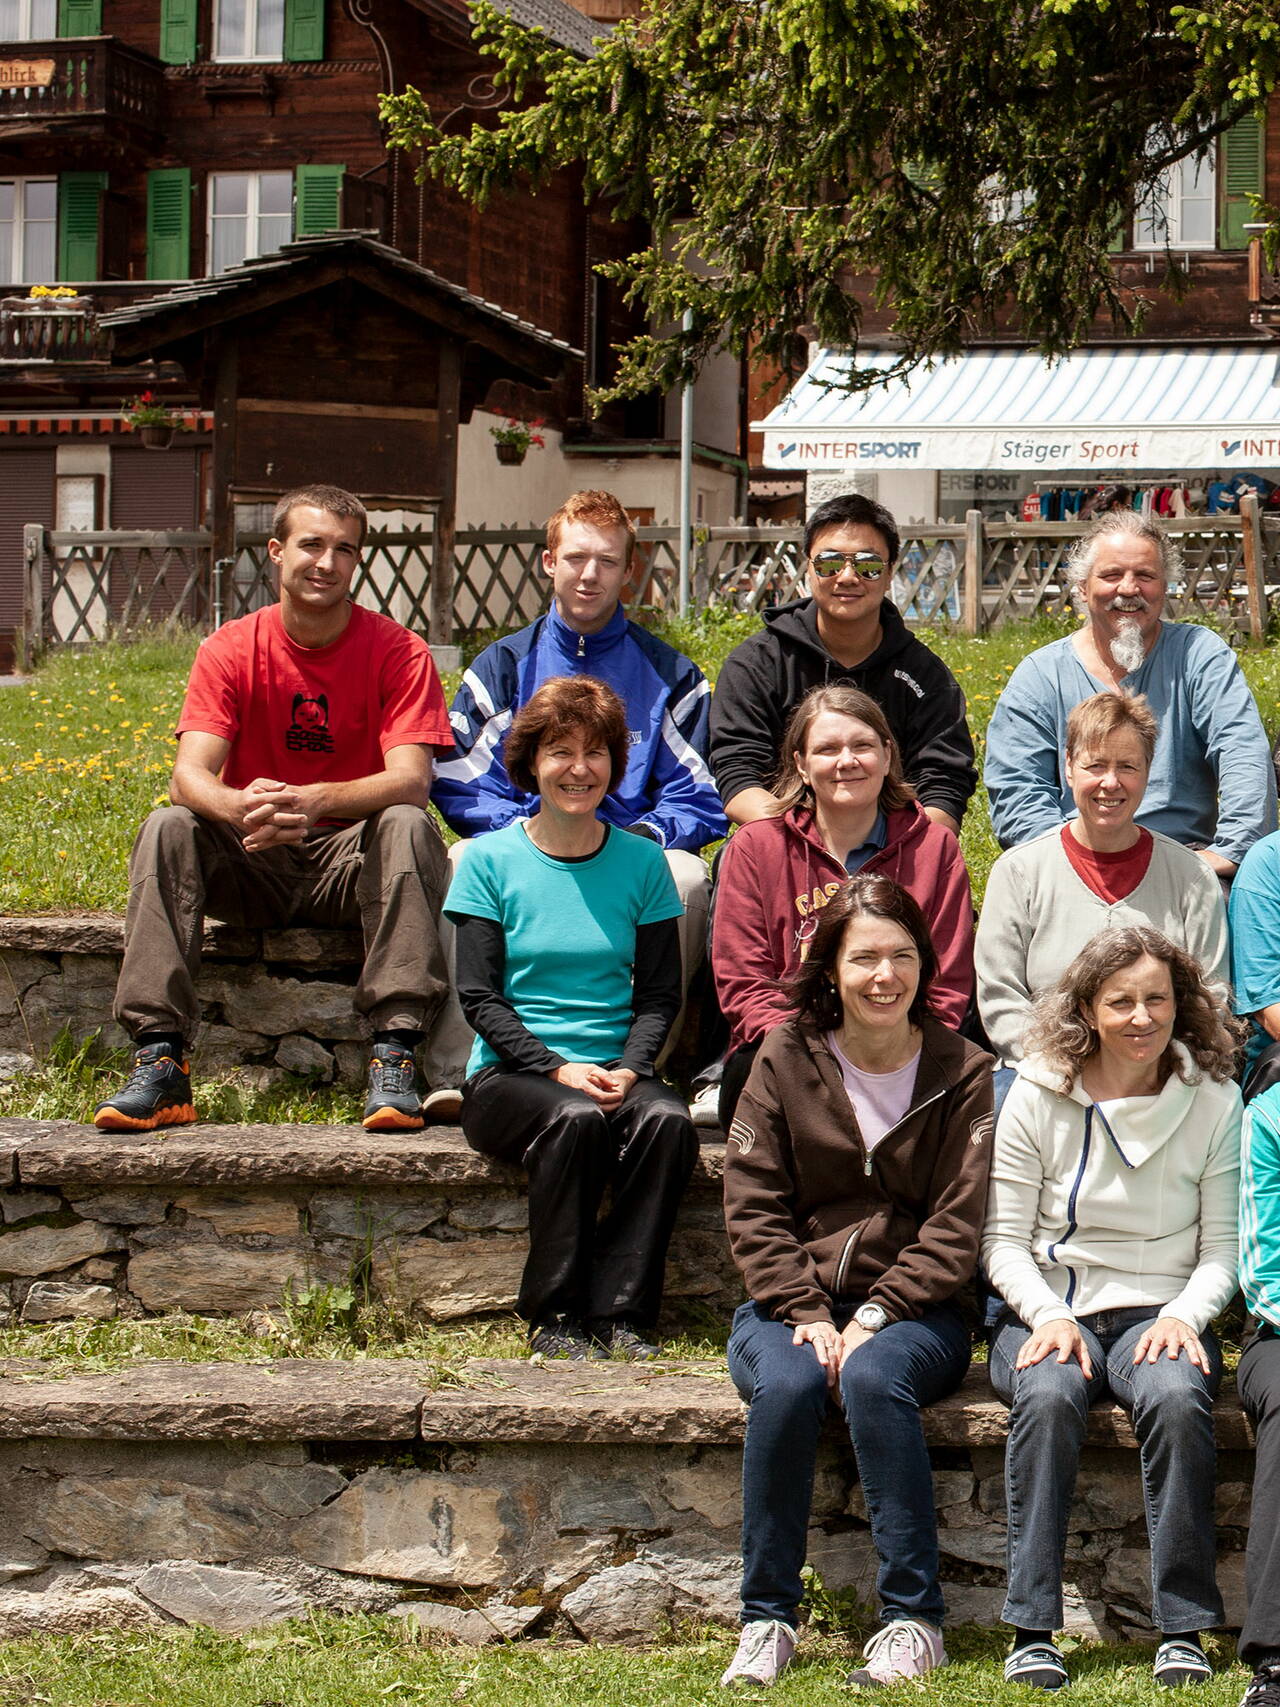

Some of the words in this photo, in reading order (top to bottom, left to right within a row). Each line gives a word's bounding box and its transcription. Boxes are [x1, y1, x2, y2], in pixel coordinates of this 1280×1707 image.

[799, 442, 922, 459] INTERSPORT
[1002, 440, 1071, 463] Stäger
[1079, 441, 1139, 462] Sport
[1024, 504, 1041, 515] SAL
